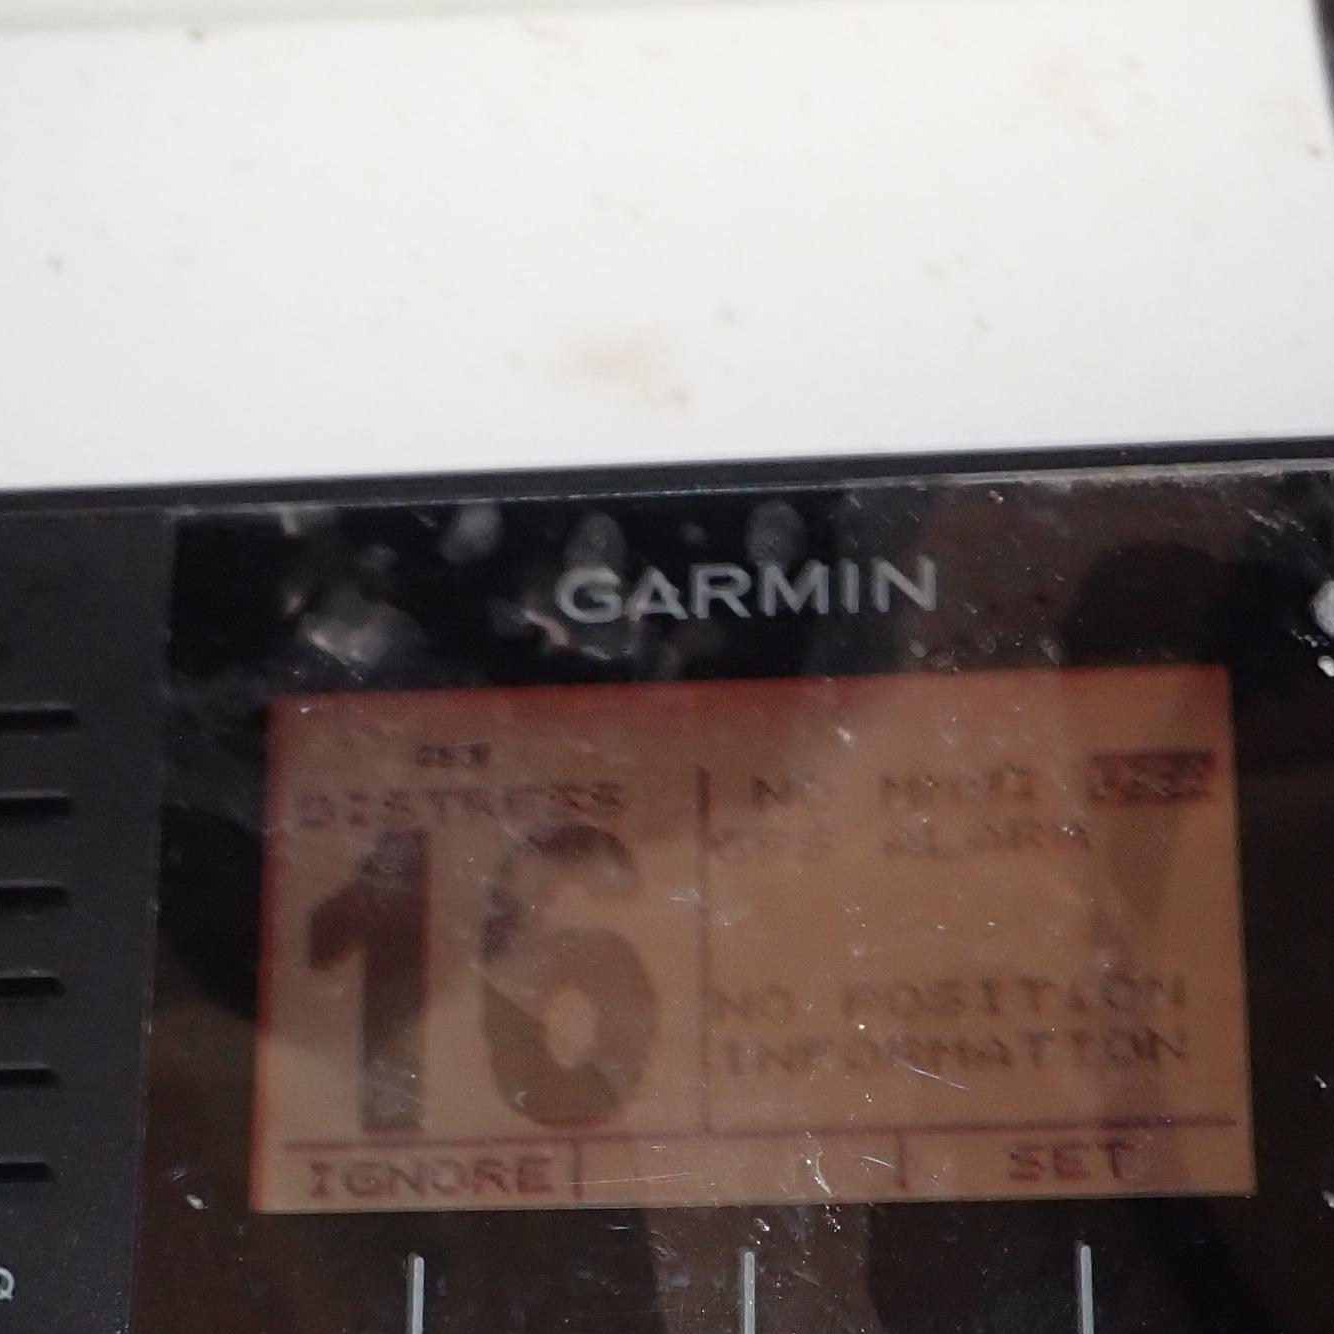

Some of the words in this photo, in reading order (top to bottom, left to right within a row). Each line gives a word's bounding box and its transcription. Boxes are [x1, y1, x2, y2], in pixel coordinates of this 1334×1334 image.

[555, 555, 939, 623] GARMIN
[305, 822, 661, 1134] 16
[841, 972, 1188, 1021] POSITION
[721, 1026, 1189, 1077] INFORMATION
[307, 1154, 555, 1198] IGNORE
[1006, 1140, 1135, 1182] SET
